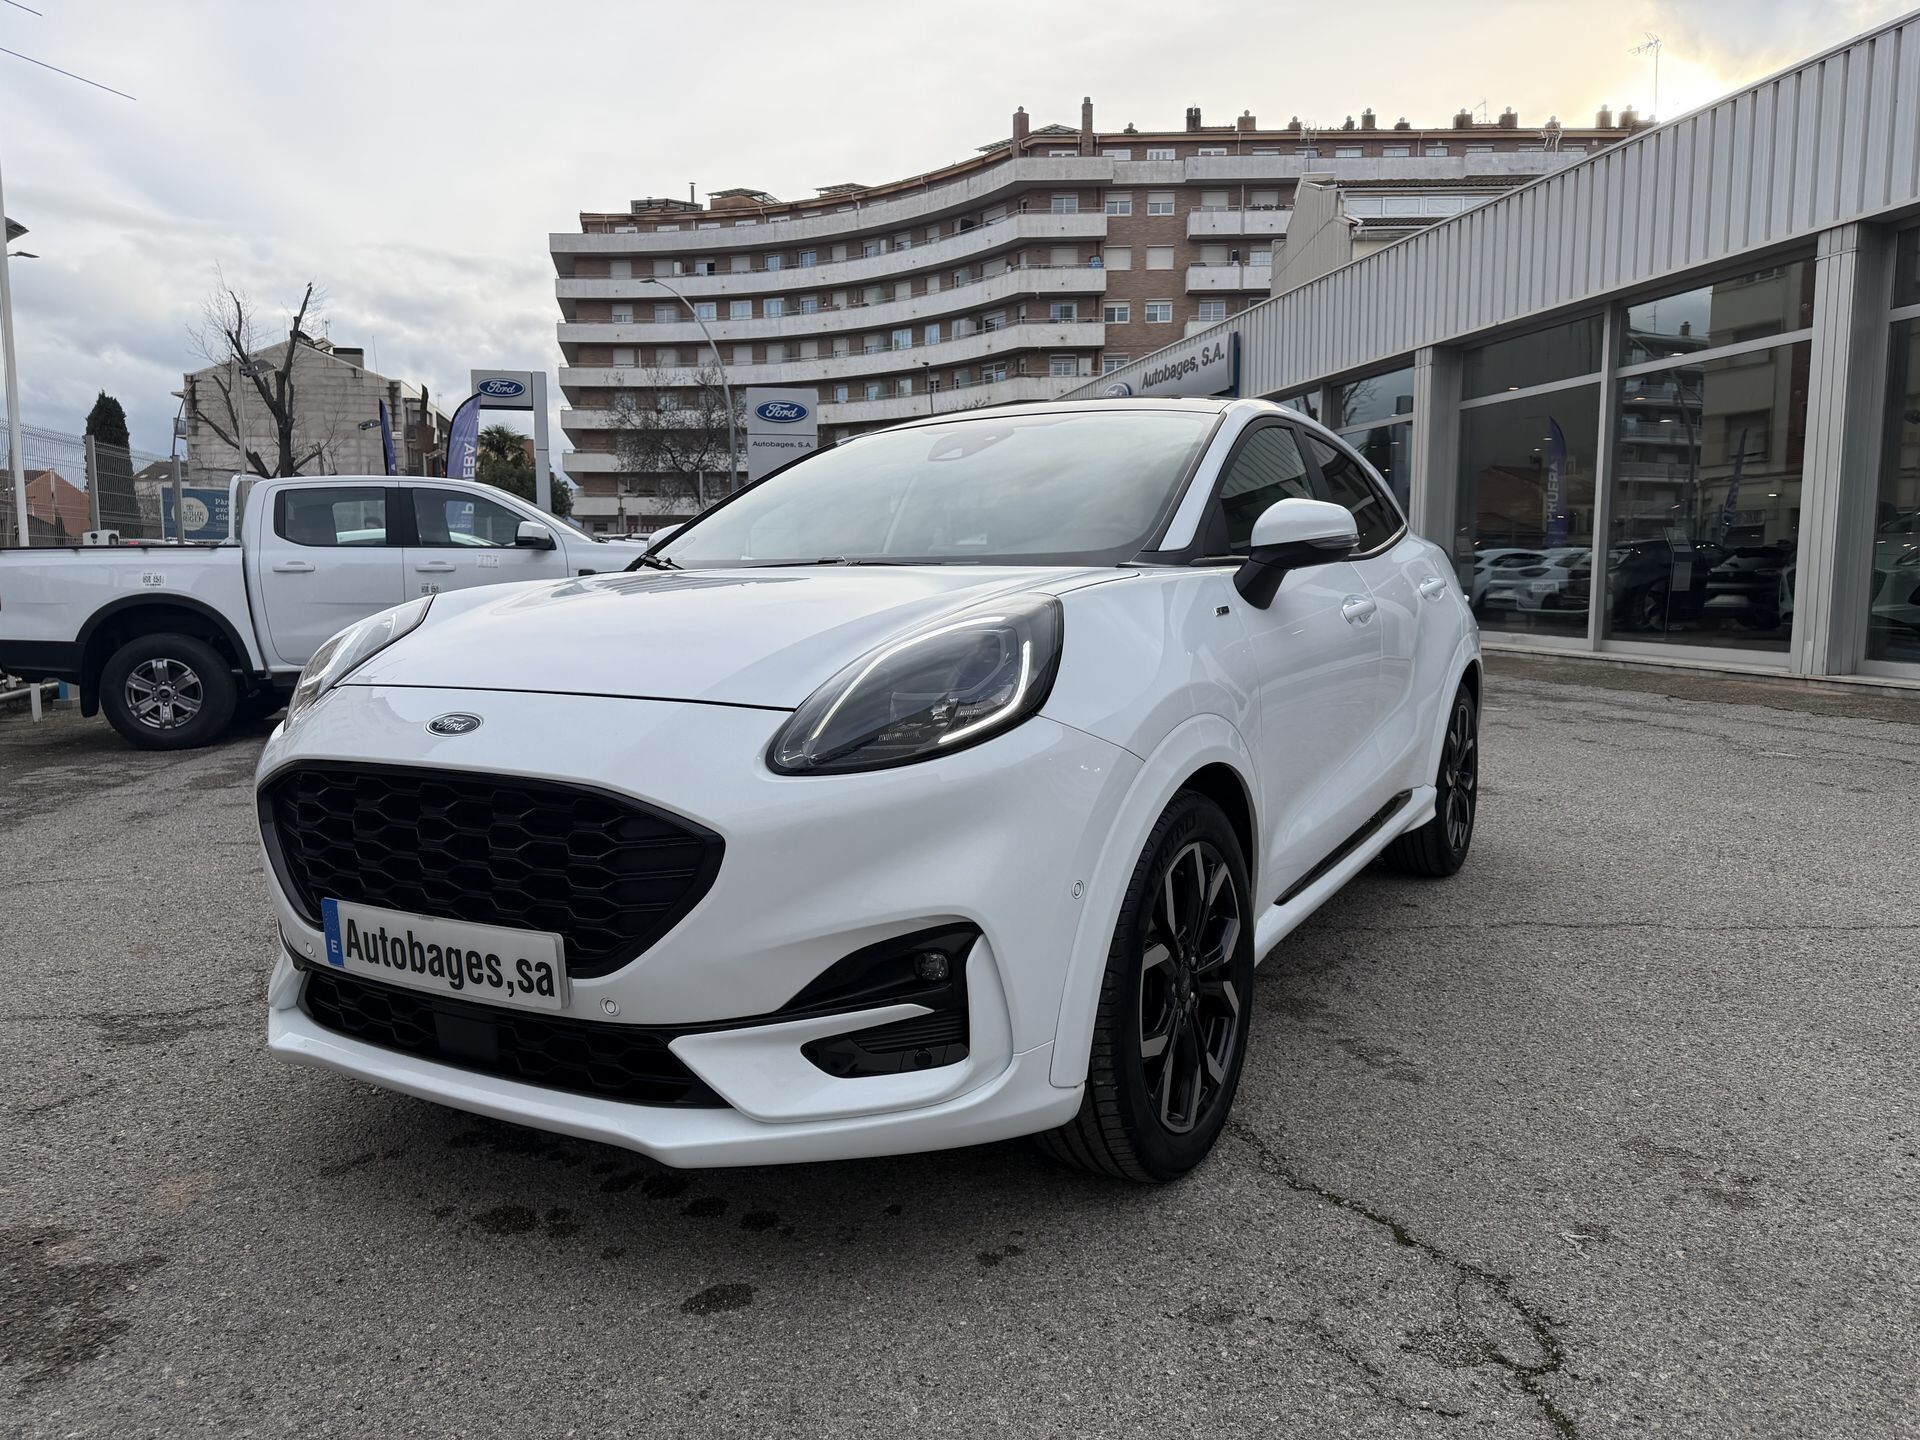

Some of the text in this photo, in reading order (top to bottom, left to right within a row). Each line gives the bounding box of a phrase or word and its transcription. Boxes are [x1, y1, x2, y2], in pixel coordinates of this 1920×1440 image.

[1142, 342, 1225, 389] Autobages, S.A.
[486, 381, 516, 394] Ford
[765, 403, 798, 418] Ford
[752, 440, 814, 449] Autobages, S.A.
[436, 716, 471, 731] Ford
[331, 939, 339, 954] E
[346, 918, 556, 998] Autobages,sa
